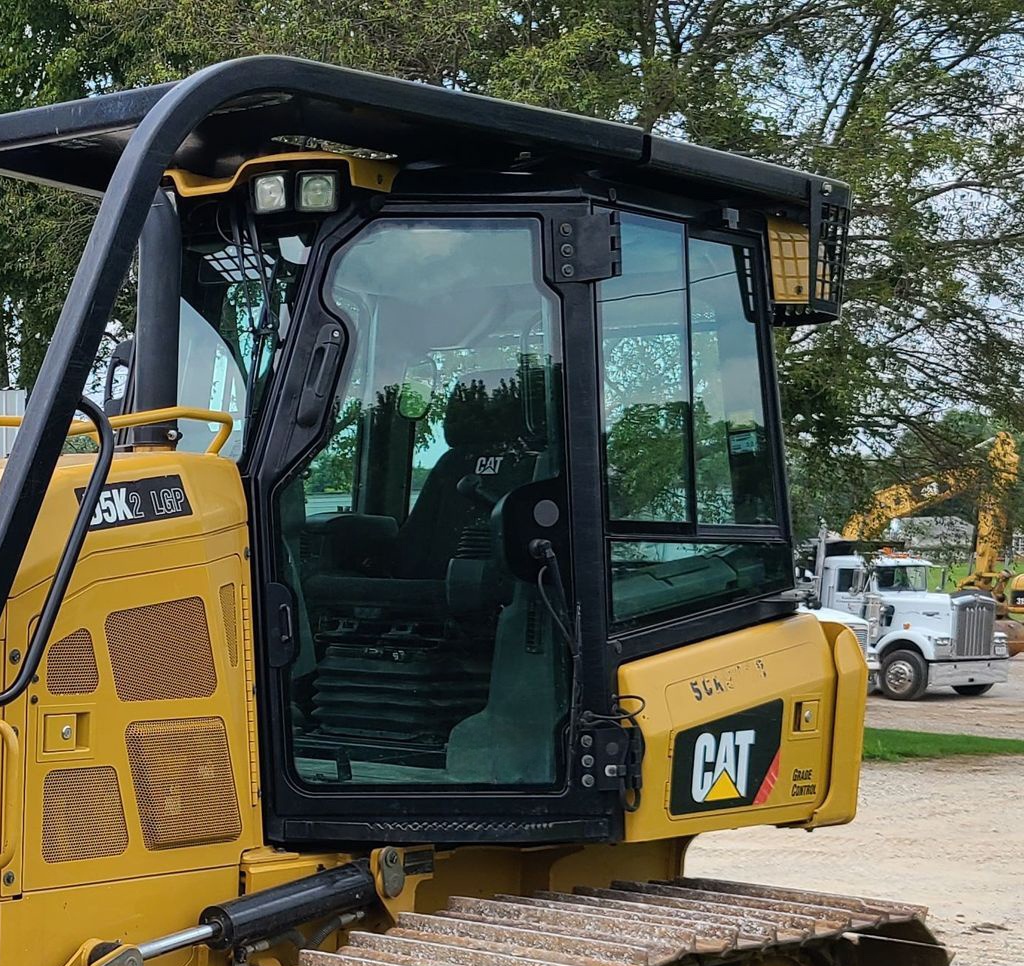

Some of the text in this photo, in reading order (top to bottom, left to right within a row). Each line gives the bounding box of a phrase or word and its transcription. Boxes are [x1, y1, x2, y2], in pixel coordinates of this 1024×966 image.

[476, 457, 503, 474] CAT
[150, 488, 185, 515] LGP
[692, 729, 755, 803] CAT
